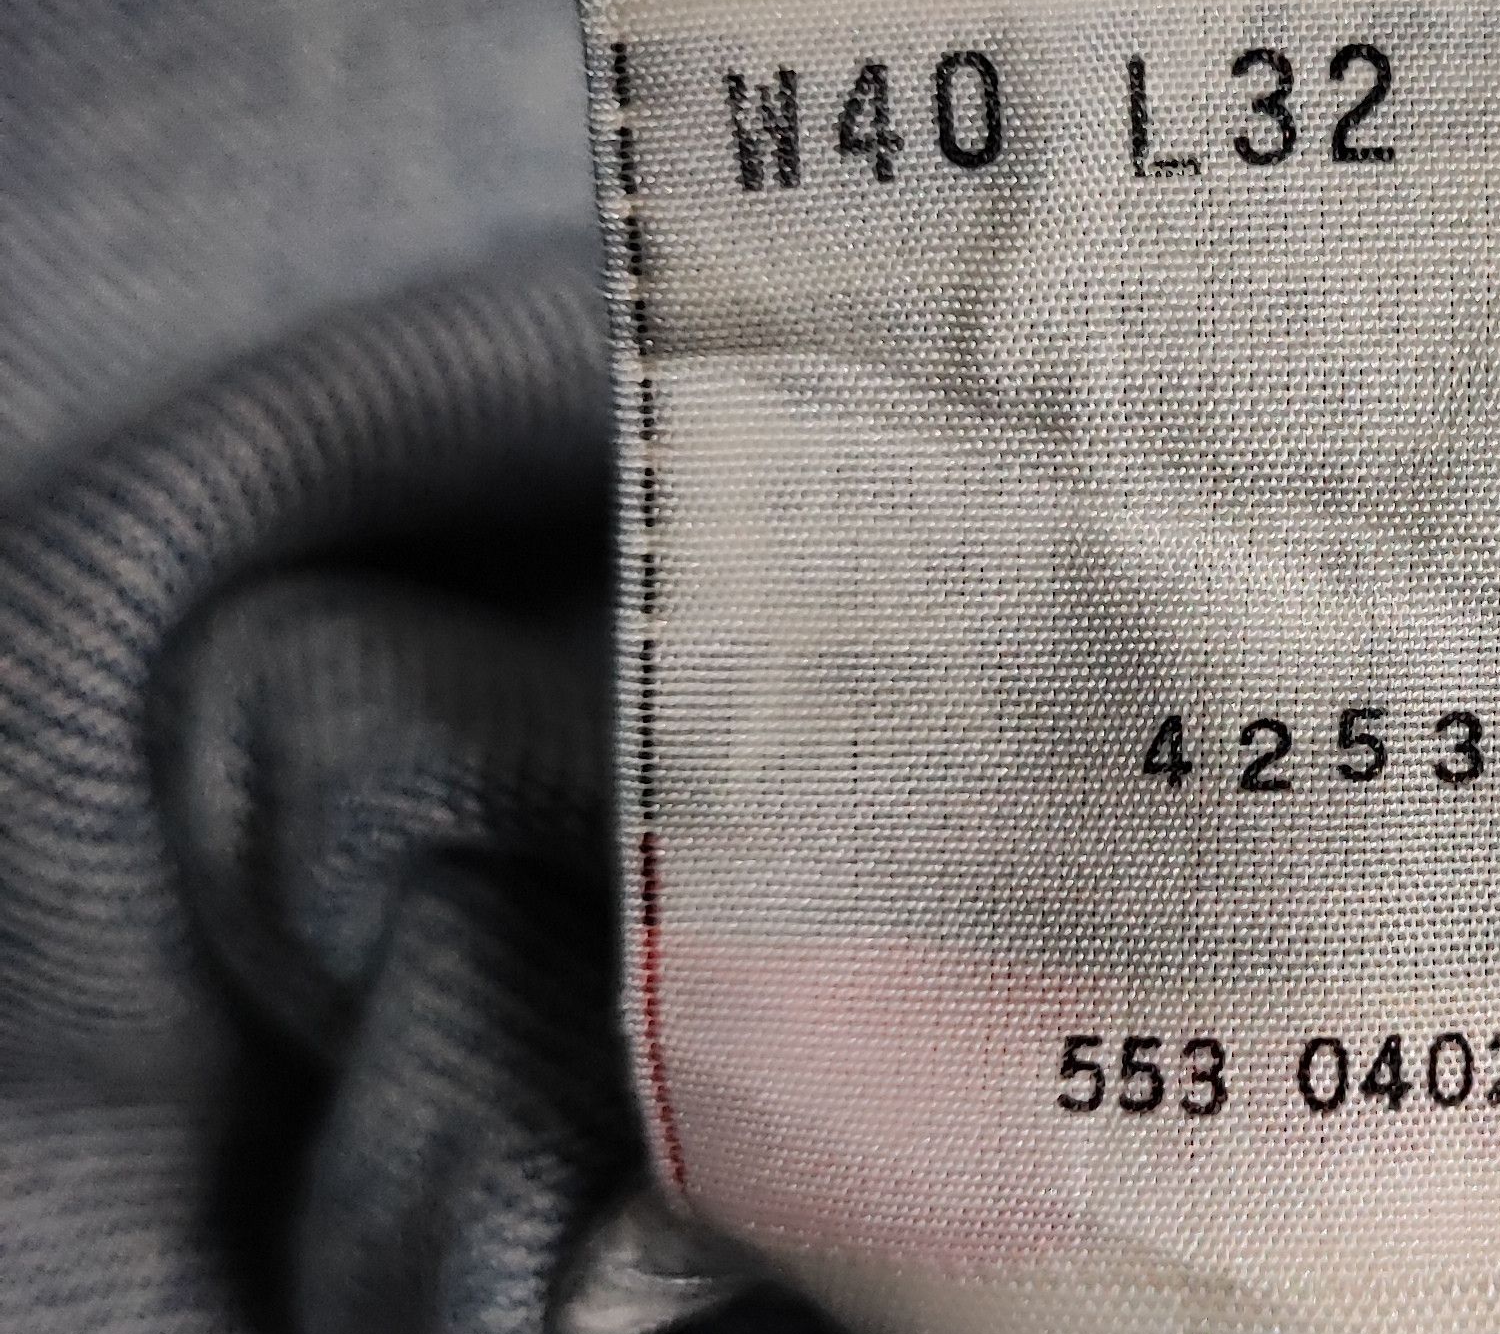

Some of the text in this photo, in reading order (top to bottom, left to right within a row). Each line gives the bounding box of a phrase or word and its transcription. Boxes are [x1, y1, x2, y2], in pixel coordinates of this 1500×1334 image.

[724, 49, 1003, 192] W40
[1130, 42, 1398, 178] L32
[1057, 1034, 1228, 1116] 553
